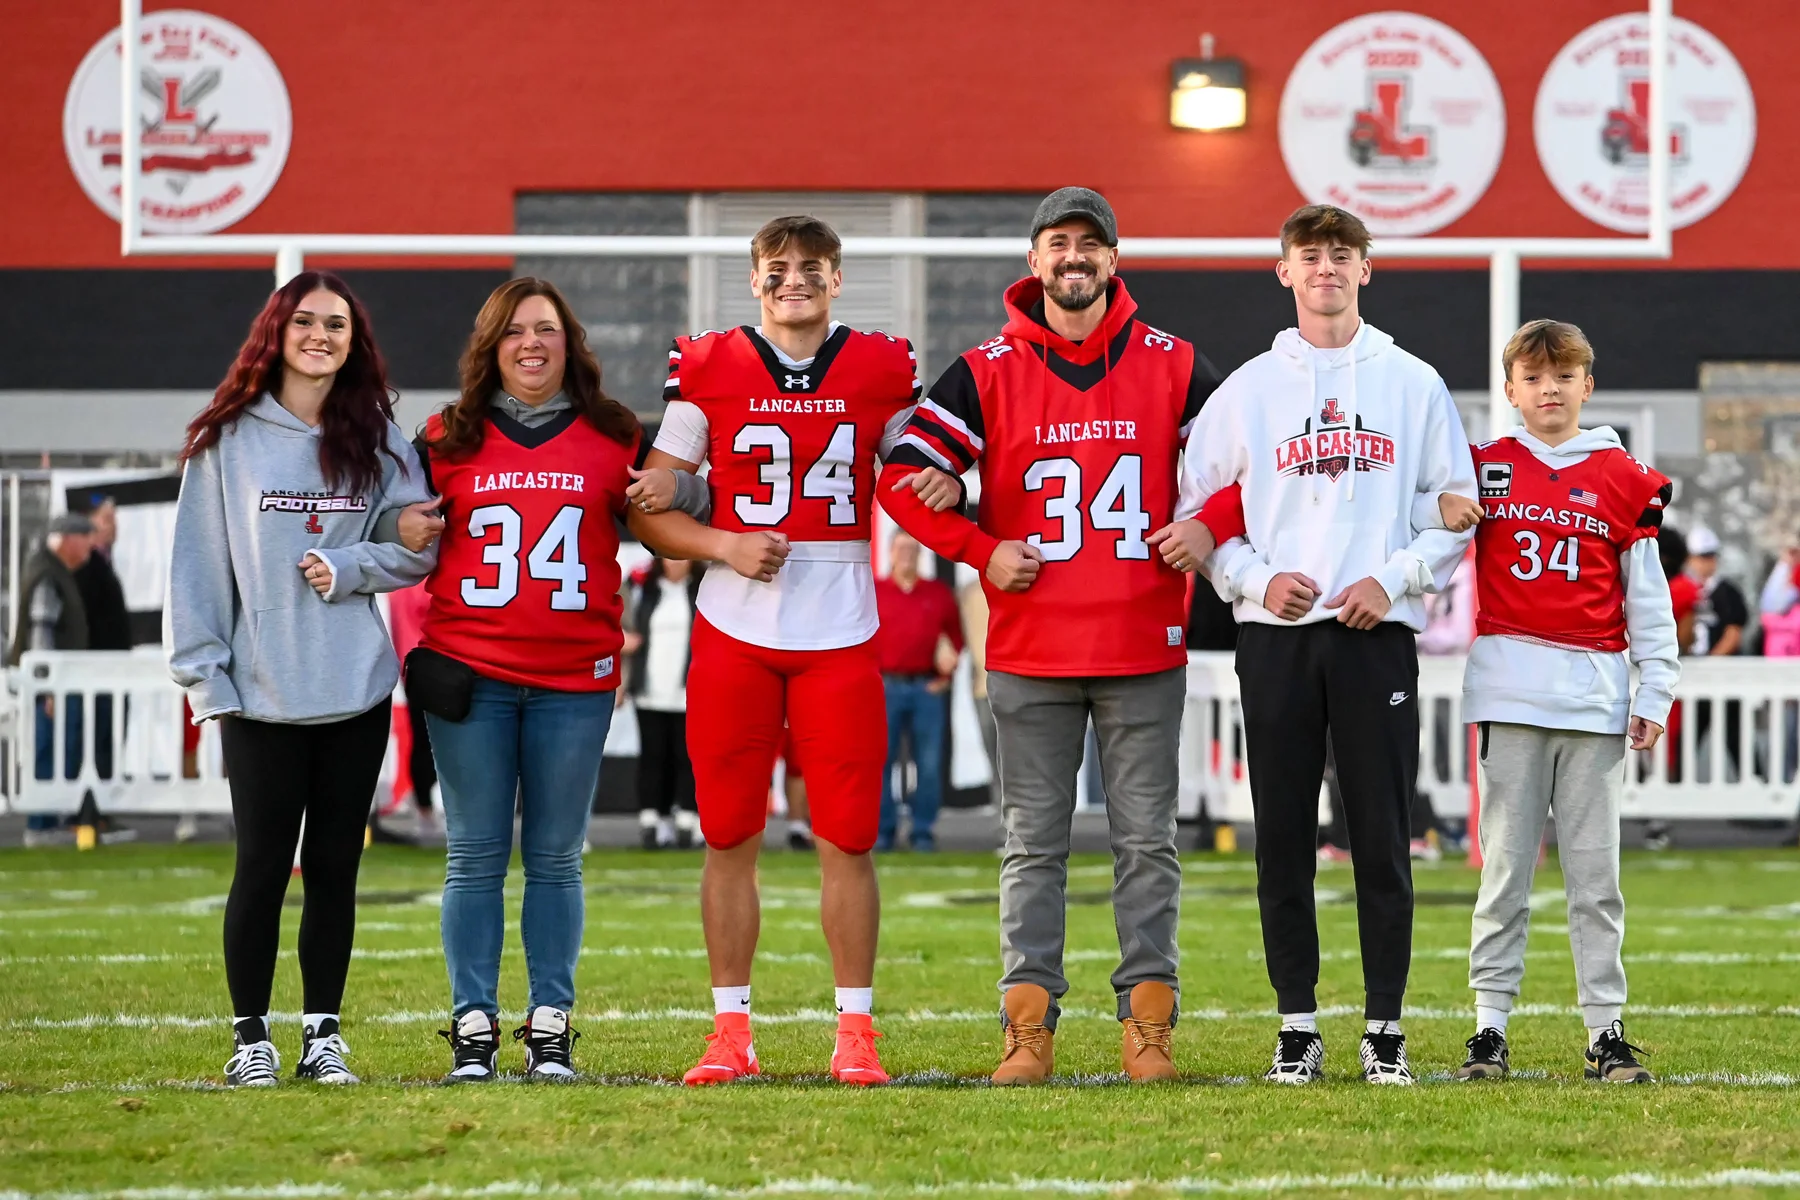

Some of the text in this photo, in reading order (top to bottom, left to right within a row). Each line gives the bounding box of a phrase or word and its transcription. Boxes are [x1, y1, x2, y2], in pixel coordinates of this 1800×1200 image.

[163, 78, 197, 123] L
[1376, 83, 1428, 160] L
[976, 335, 1014, 361] 34
[749, 398, 846, 413] LANCASTER
[1034, 419, 1136, 445] LANCASTER
[1275, 431, 1395, 472] LANCASTER
[473, 471, 585, 493] LANCASTER
[732, 422, 857, 526] 34
[1480, 464, 1511, 489] C
[260, 495, 367, 513] FOOTBALL
[261, 489, 334, 498] LANCASTER
[1023, 454, 1150, 562] 34
[1485, 504, 1610, 539] LANCASTER
[460, 503, 588, 612] 34
[1510, 529, 1580, 582] 34
